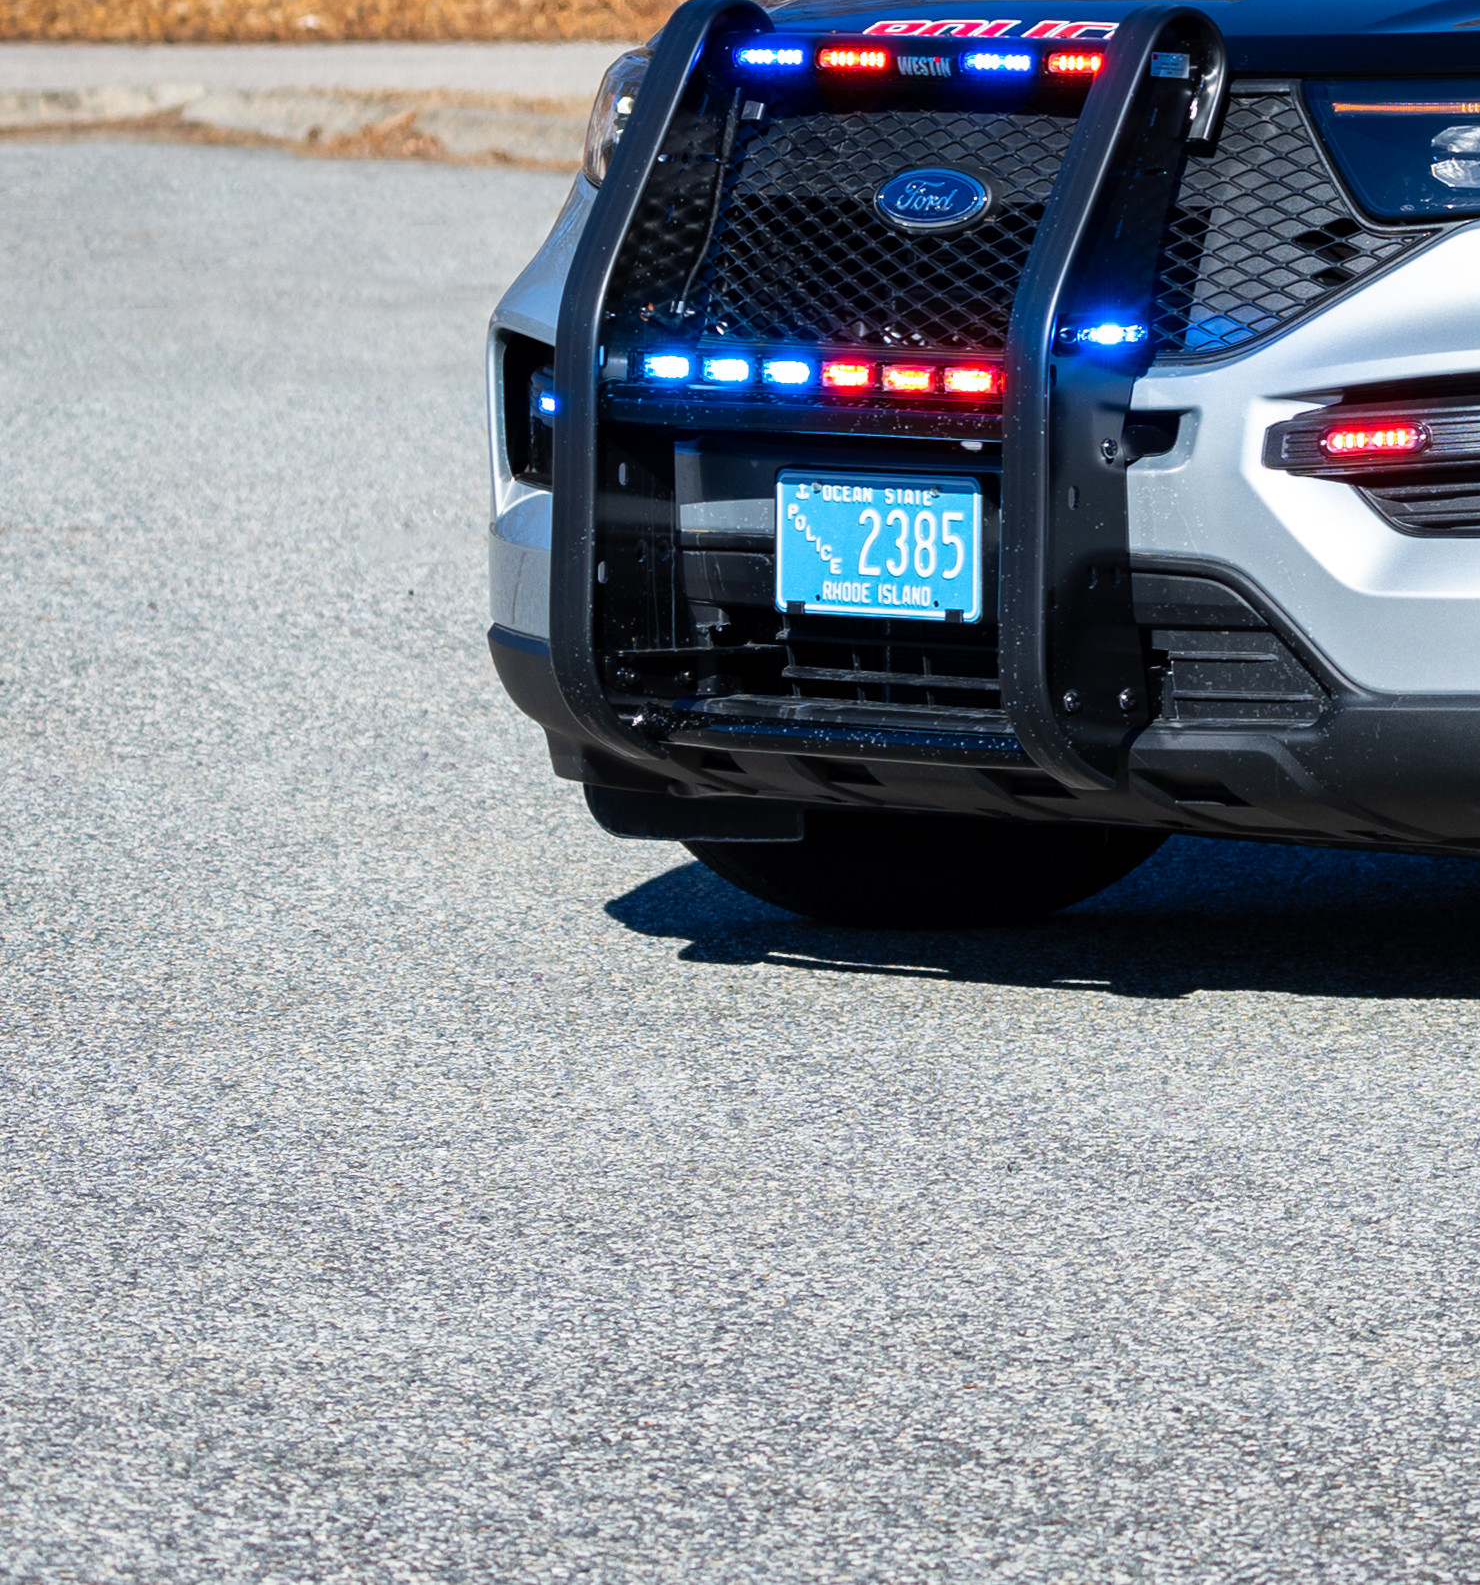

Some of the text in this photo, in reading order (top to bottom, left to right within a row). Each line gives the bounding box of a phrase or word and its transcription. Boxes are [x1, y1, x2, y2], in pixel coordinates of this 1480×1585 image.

[895, 178, 958, 211] Ford
[822, 484, 934, 506] OCEAN STATE
[787, 503, 842, 575] POLICE
[858, 508, 965, 580] 2385
[822, 581, 931, 607] RHODE ISLAND
